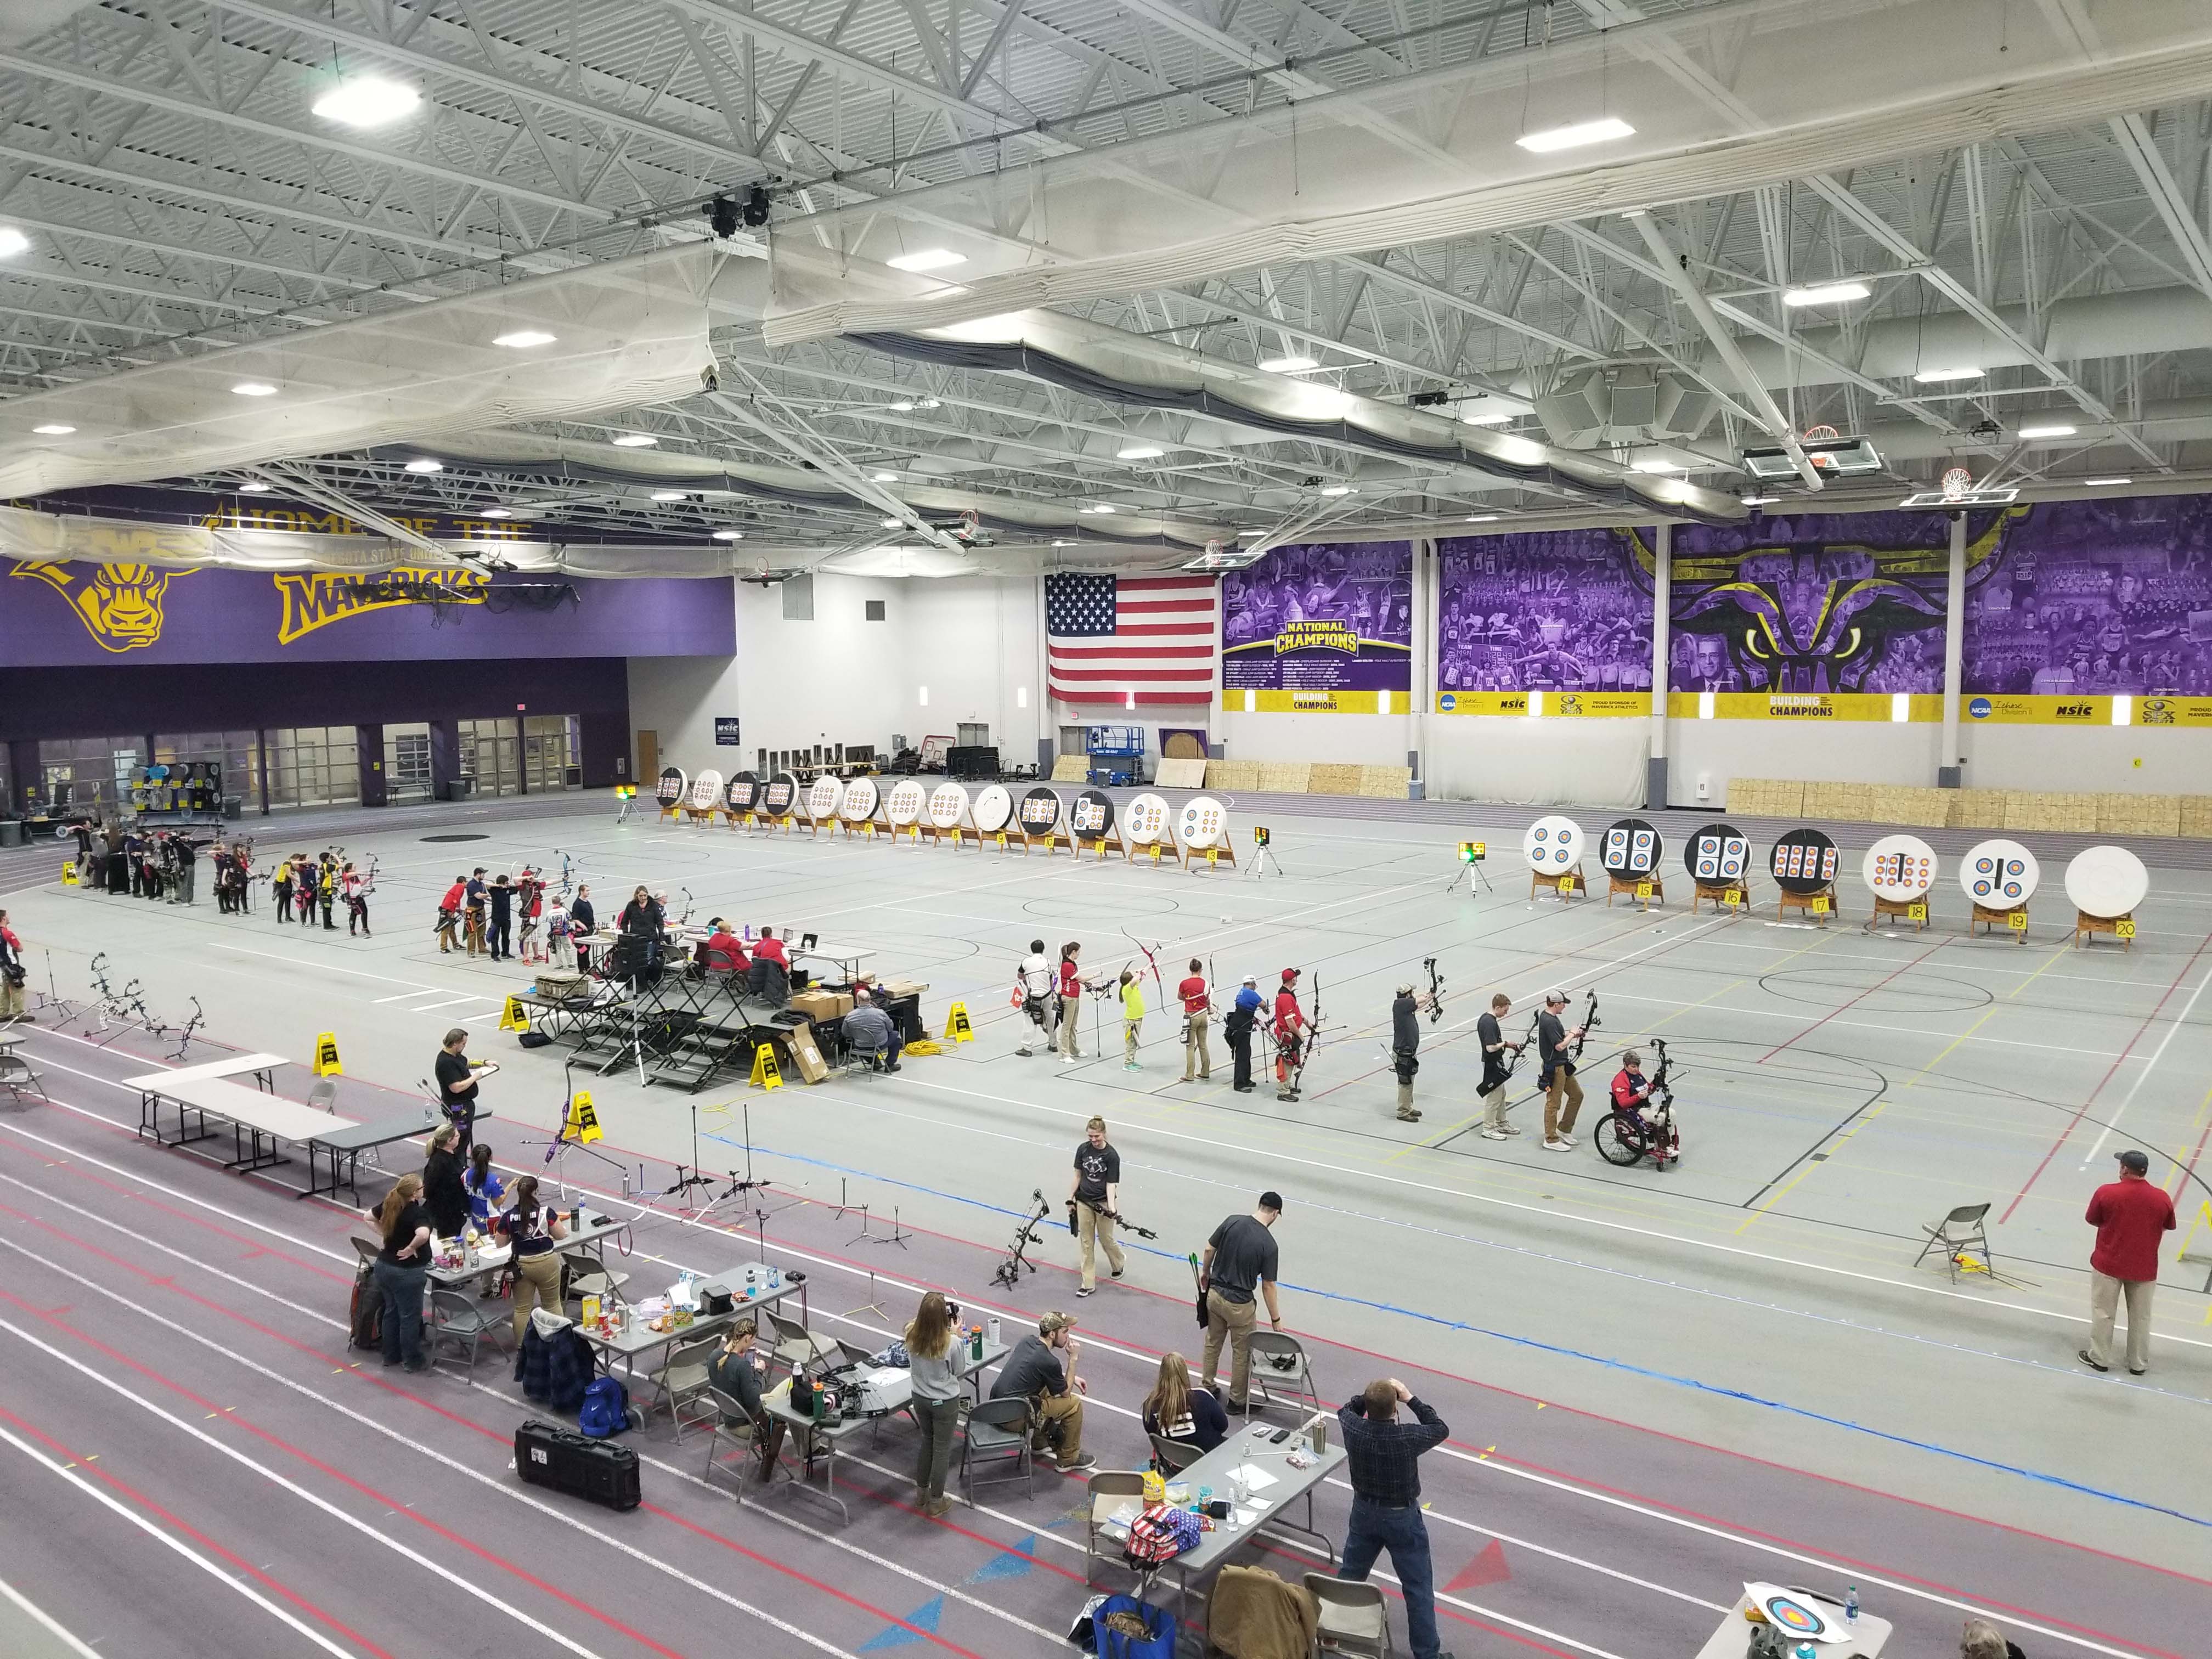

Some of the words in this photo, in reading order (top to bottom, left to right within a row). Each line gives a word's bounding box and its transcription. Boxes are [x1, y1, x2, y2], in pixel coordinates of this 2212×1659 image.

[1287, 622, 1346, 633] NATIONAL
[1276, 633, 1358, 654] CHAMPIONS
[1293, 692, 1328, 701] BUILDING
[1770, 696, 1820, 706] BUILDING
[1294, 702, 1337, 710] CHAMPIONS
[1770, 706, 1833, 716] CHAMPIONS
[2142, 710, 2176, 719] SPX
[829, 821, 833, 829] 5
[953, 831, 958, 839] 8
[998, 834, 1003, 842] 9
[1046, 838, 1054, 847] 10
[1097, 843, 1103, 851] 11
[1152, 848, 1159, 856] 12
[1209, 851, 1216, 860] 13
[1562, 879, 1571, 890] 14
[1641, 886, 1650, 896] 15
[1728, 893, 1738, 903] 16
[1816, 900, 1826, 912] 17
[1912, 907, 1923, 918] 18
[2013, 916, 2023, 927] 19
[2118, 924, 2135, 936] 20
